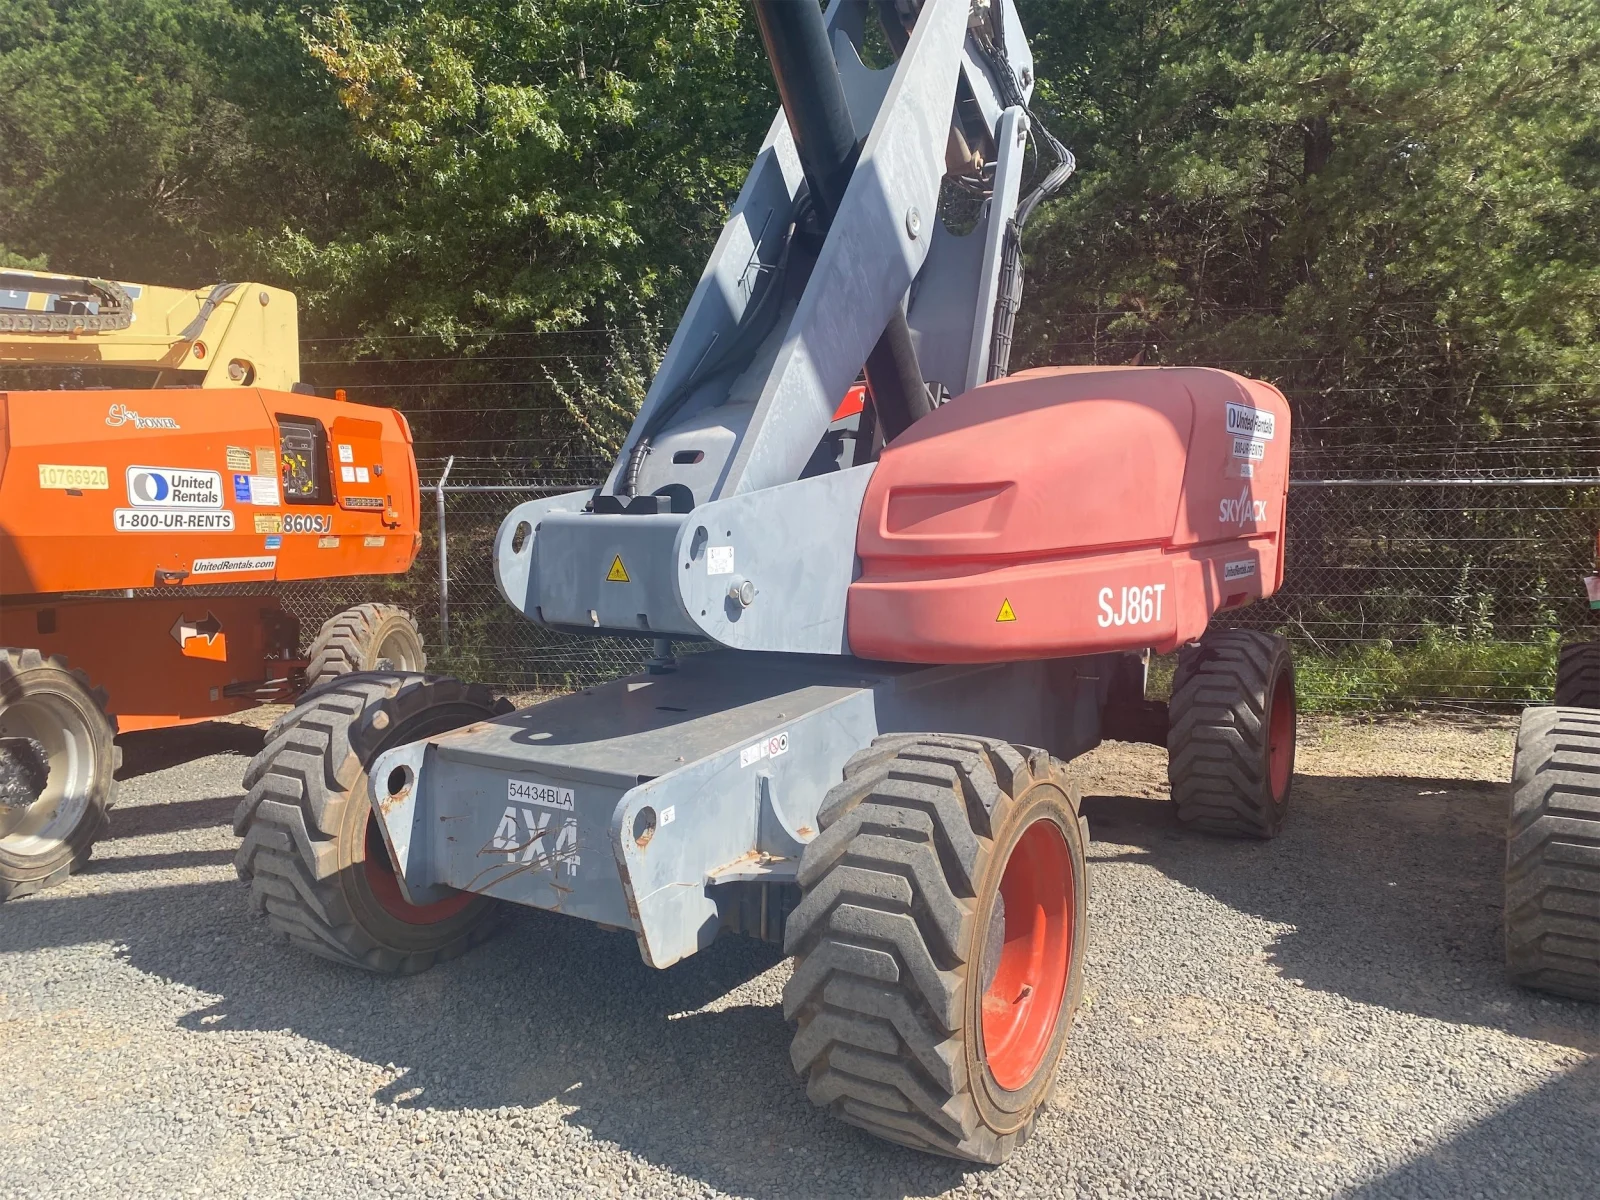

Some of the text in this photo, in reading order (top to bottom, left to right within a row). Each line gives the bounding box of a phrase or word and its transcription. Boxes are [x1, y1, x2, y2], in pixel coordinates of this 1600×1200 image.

[138, 418, 177, 428] POWER
[1236, 410, 1273, 435] United Rentals
[40, 468, 107, 486] 10766920
[171, 475, 213, 490] United
[172, 489, 218, 503] Rentals
[1218, 485, 1267, 527] SKYJACK
[117, 514, 231, 528] 1-800-UR-RENTS
[284, 514, 332, 533] 860SJ
[193, 559, 275, 573] UnitedRentals.com
[1097, 583, 1166, 628] SJ86T
[509, 782, 573, 807] 54434BLA
[493, 806, 581, 877] 4X4
